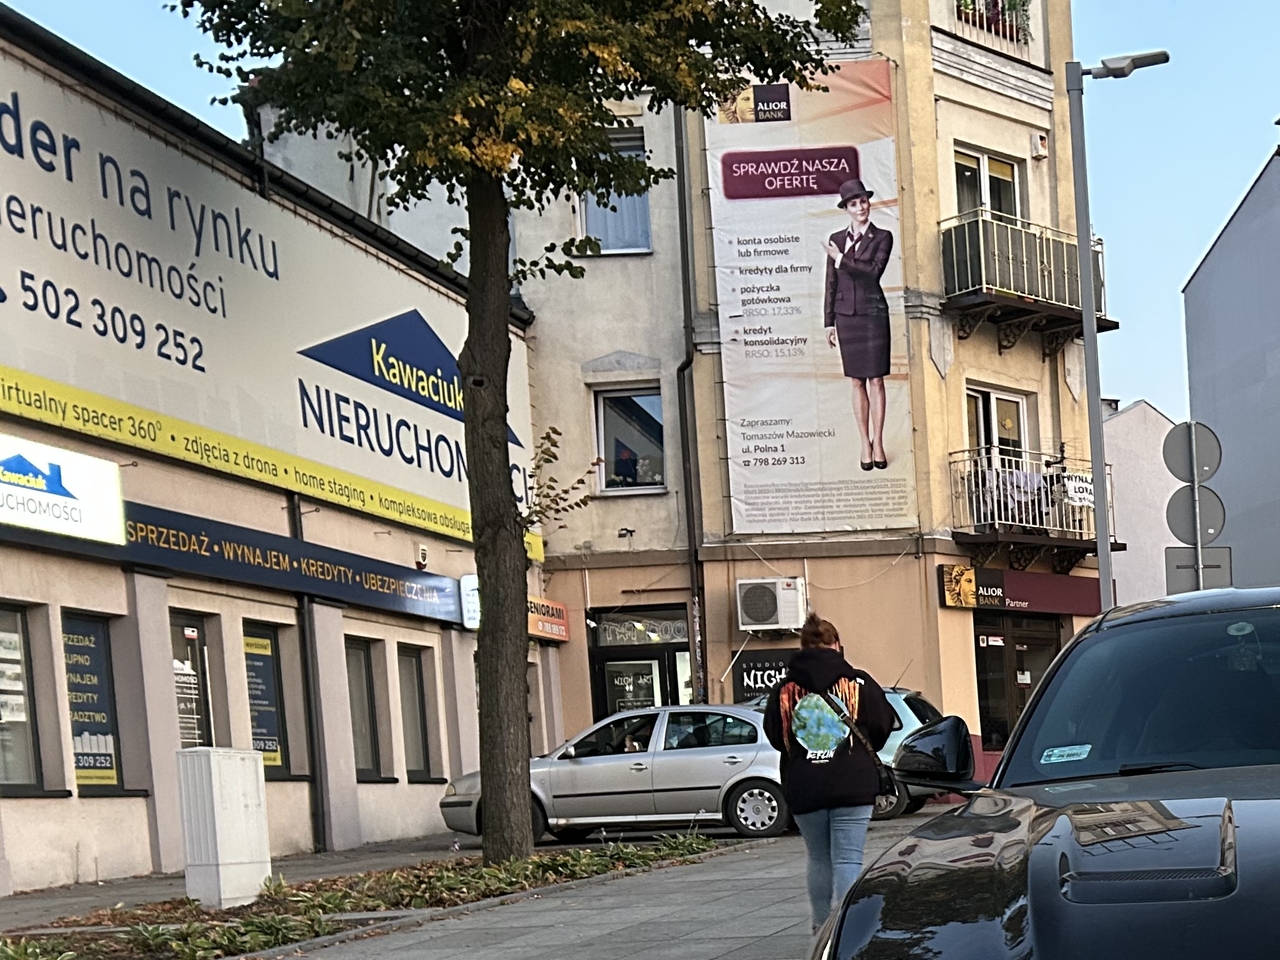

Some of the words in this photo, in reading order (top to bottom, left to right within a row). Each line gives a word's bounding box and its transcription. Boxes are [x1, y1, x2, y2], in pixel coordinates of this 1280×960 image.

[757, 101, 787, 111] ALIOR
[758, 110, 784, 120] BANK
[732, 158, 799, 176] SPRAWDŹ
[802, 158, 849, 173] NASZĄ
[765, 174, 817, 190] OFERTĘ
[99, 152, 152, 220] na
[167, 186, 279, 281] rynku
[737, 237, 762, 246] konta
[763, 235, 800, 245] osobiste
[738, 249, 752, 258] lub
[753, 248, 789, 256] firmowe
[739, 266, 773, 276] kredyty
[775, 265, 788, 274] dla
[790, 264, 813, 275] firmy
[740, 284, 780, 295] pożyczka
[741, 296, 791, 307] gotówkowa
[20, 269, 82, 329] 502
[91, 298, 146, 350] 309
[155, 323, 206, 373] 252
[743, 326, 772, 336] kredyt
[744, 337, 807, 347] konsolidacyjny
[371, 338, 464, 411] Kawaciuk
[740, 417, 793, 428] Zapraszamy:
[741, 430, 784, 441] Tomaszów
[786, 428, 836, 440] Mazowiecki
[741, 445, 752, 454] ul.
[754, 444, 778, 453] Polna
[780, 444, 786, 453] 1
[753, 457, 770, 467] 798
[772, 457, 788, 466] 269
[789, 456, 805, 466] 313
[72, 402, 124, 433] spacer
[183, 435, 230, 463] zdjęcia
[233, 451, 240, 466] z
[243, 451, 278, 477] drona
[294, 467, 325, 491] home
[328, 480, 366, 507] staging
[378, 492, 438, 525] kompleksowa
[439, 509, 470, 536] obsługa
[126, 520, 210, 556] SPRZEDAŻ
[221, 540, 290, 572] WYNAJEM
[301, 557, 353, 585] KREDYTY
[362, 571, 439, 604] UBEZPIECZENIA
[978, 586, 1003, 597] ALIOR
[979, 596, 1000, 606] BANK
[1005, 598, 1028, 608] Partner
[265, 740, 277, 750] 252
[78, 755, 94, 767] 309
[95, 756, 111, 767] 252
